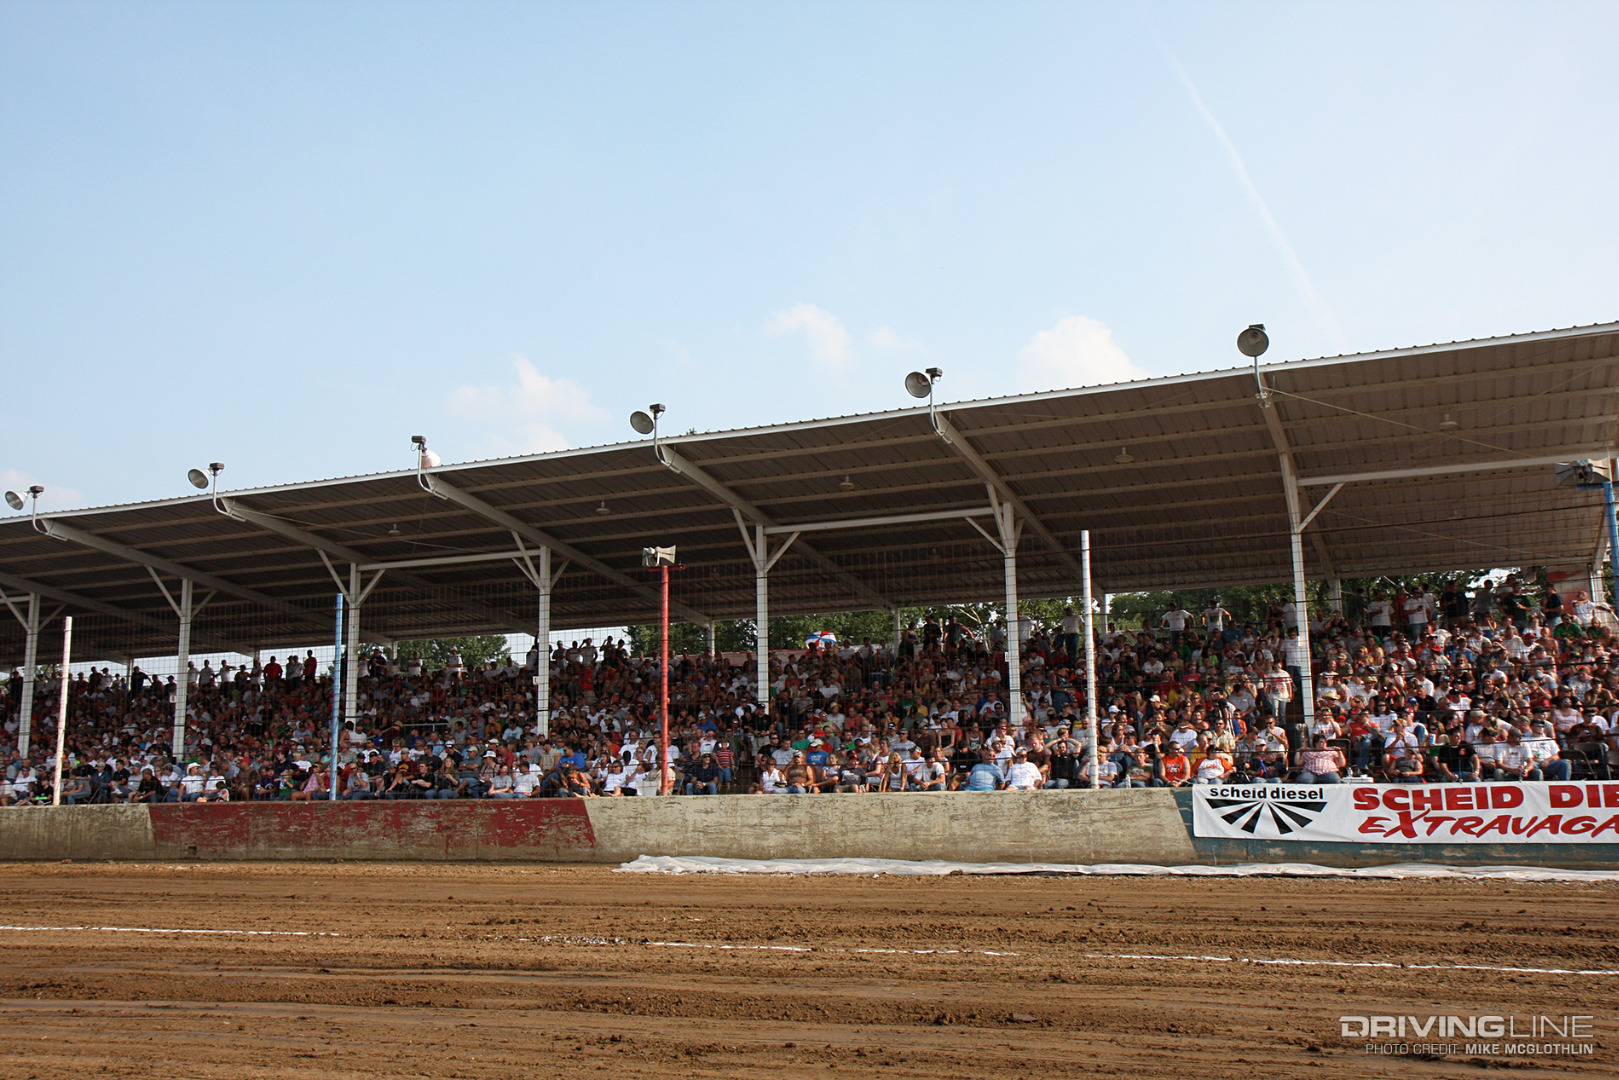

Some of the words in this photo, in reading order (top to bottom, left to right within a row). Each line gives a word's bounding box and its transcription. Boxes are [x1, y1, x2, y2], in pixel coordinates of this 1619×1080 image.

[1209, 787, 1267, 800] scheid
[1270, 787, 1324, 800] diesel
[1353, 786, 1524, 811] SCHEID
